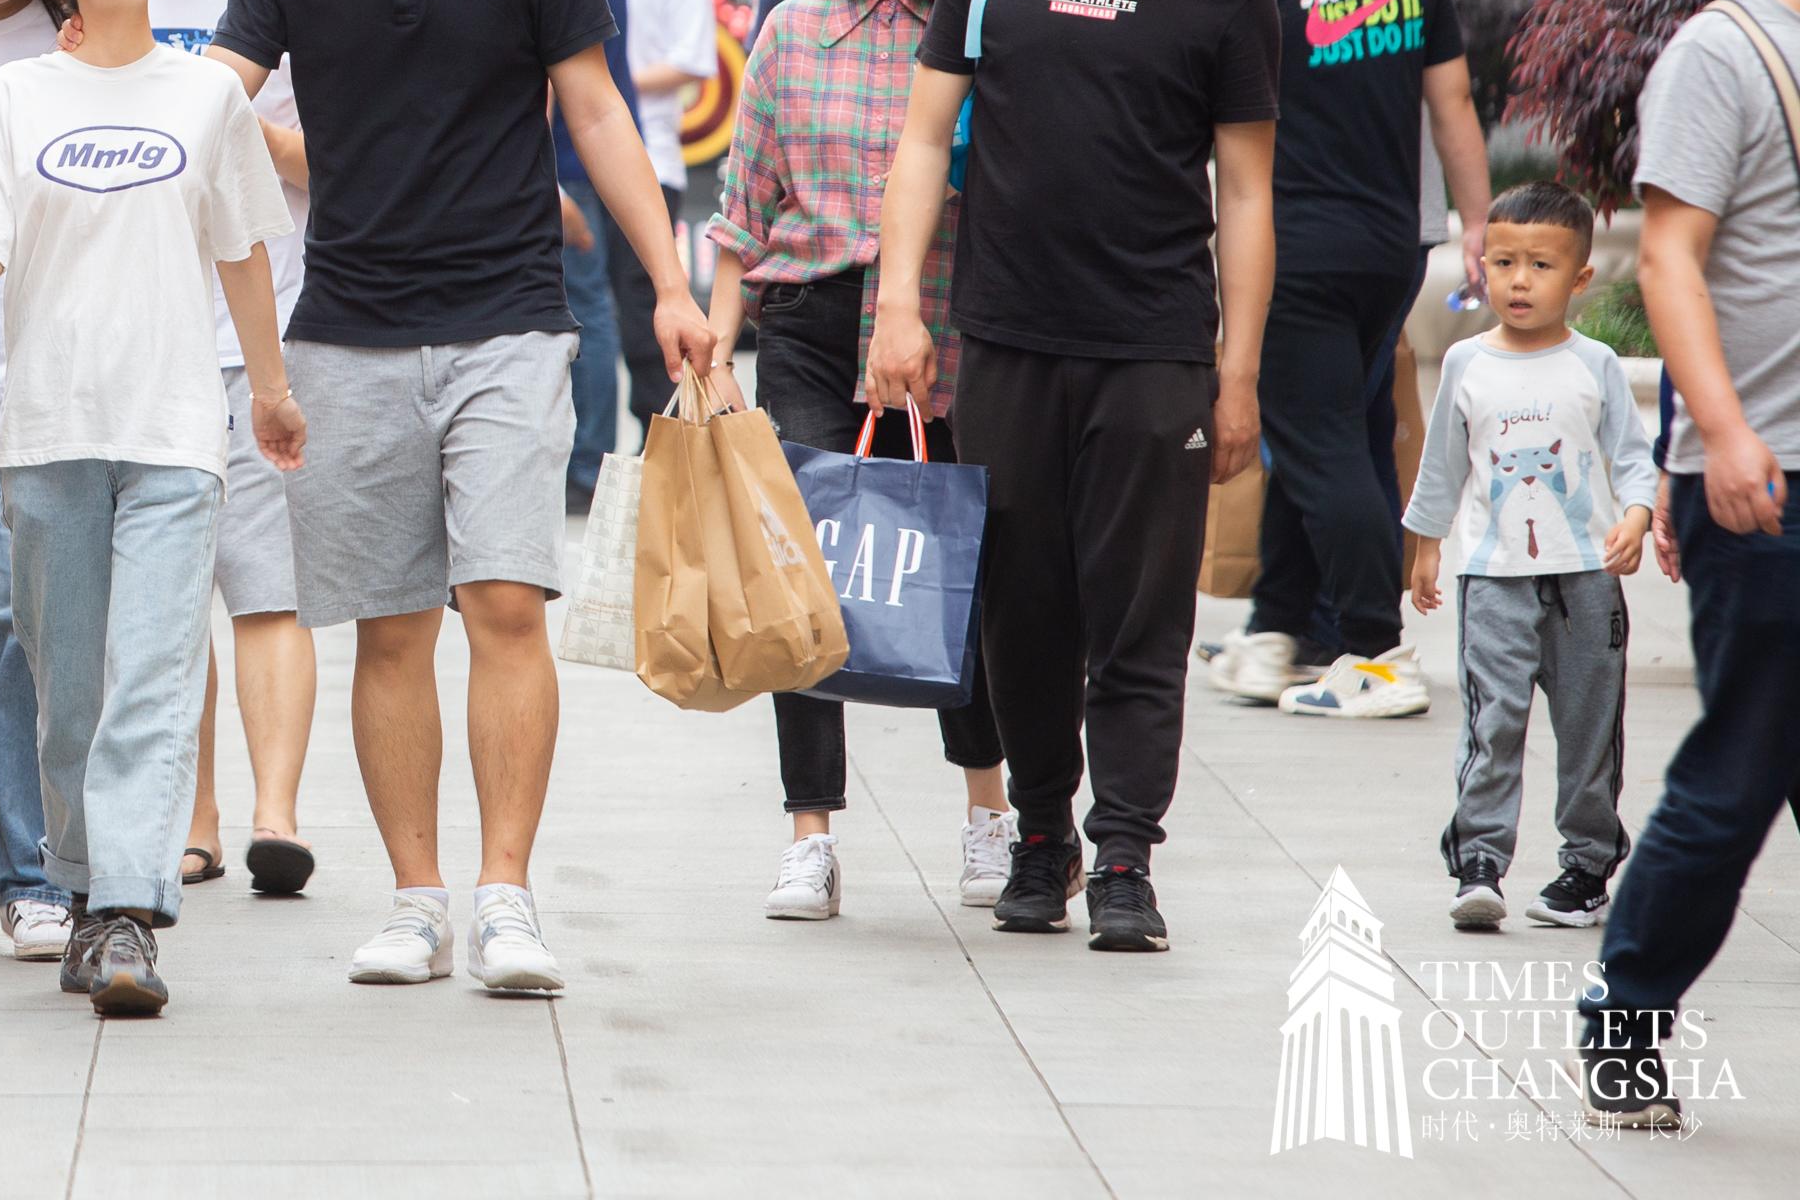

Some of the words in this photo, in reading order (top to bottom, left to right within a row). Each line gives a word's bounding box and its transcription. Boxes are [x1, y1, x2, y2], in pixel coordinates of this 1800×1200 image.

[1309, 28, 1365, 68] JUST
[1367, 22, 1402, 57] DO
[1497, 398, 1553, 435] yeah!
[816, 518, 925, 607] GAP
